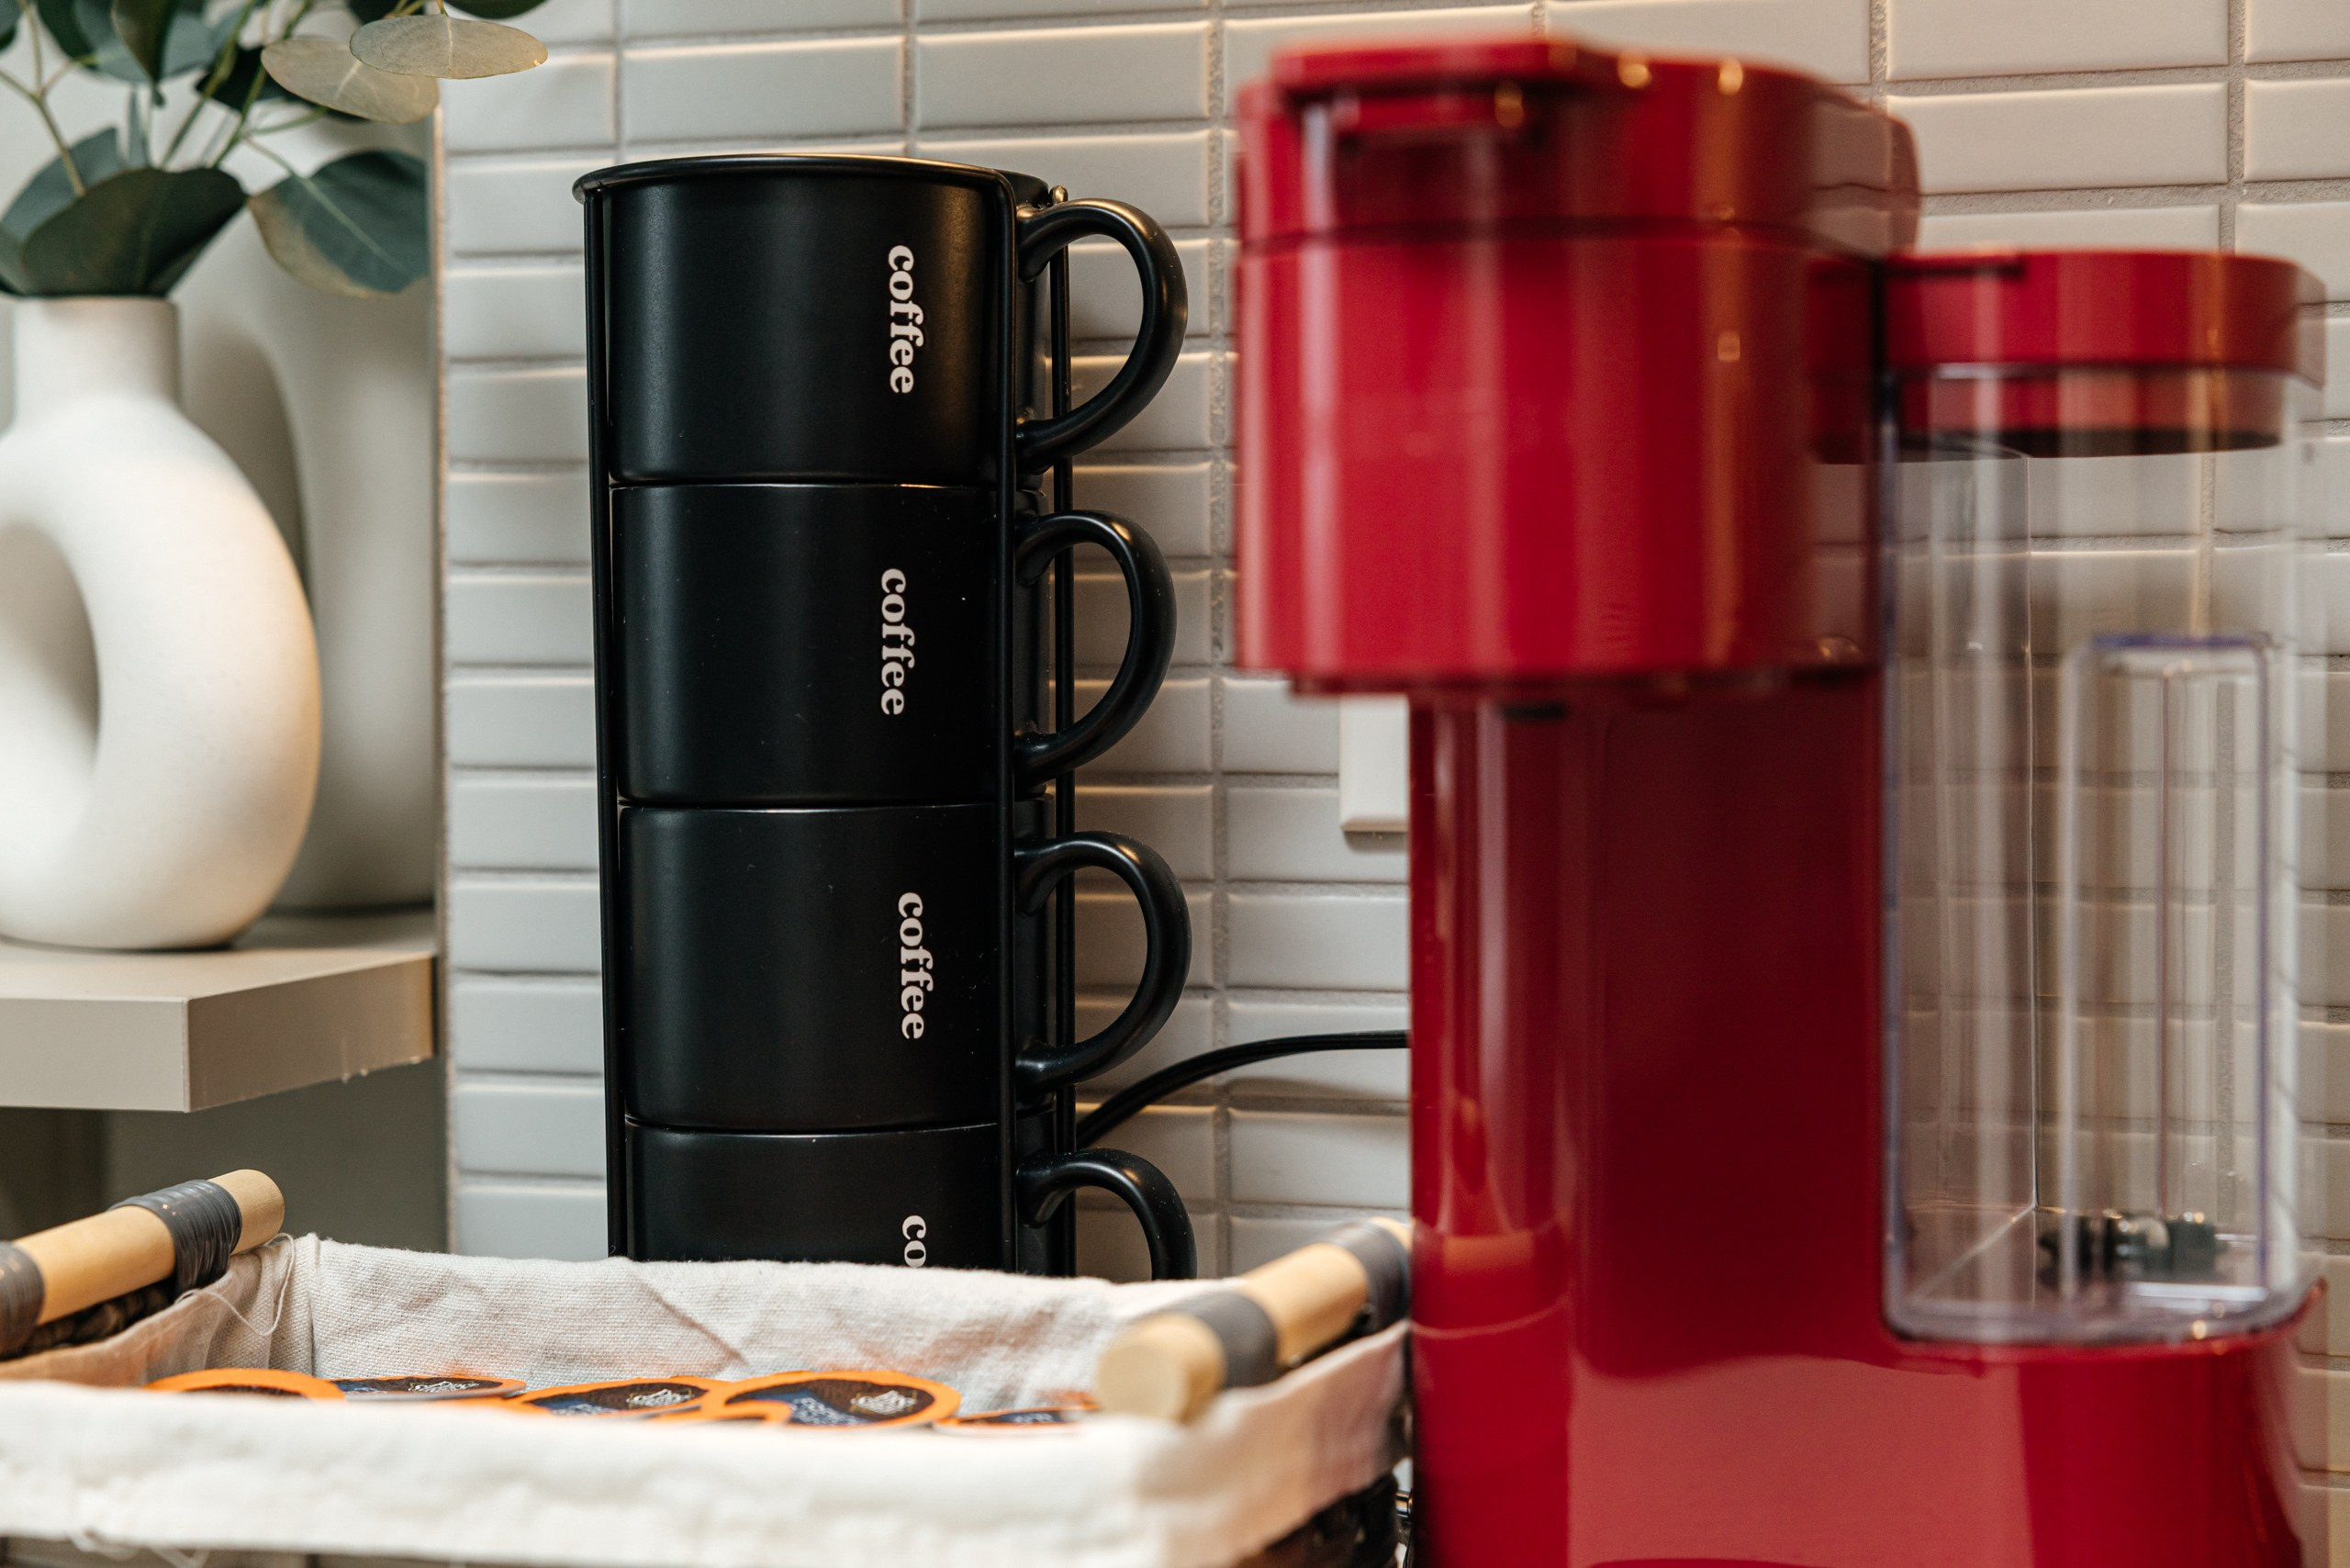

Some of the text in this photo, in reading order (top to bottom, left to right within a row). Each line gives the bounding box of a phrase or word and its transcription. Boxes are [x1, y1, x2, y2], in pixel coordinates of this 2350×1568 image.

[888, 245, 924, 394] coffee
[880, 568, 915, 715] coffee
[898, 892, 934, 1039] coffee
